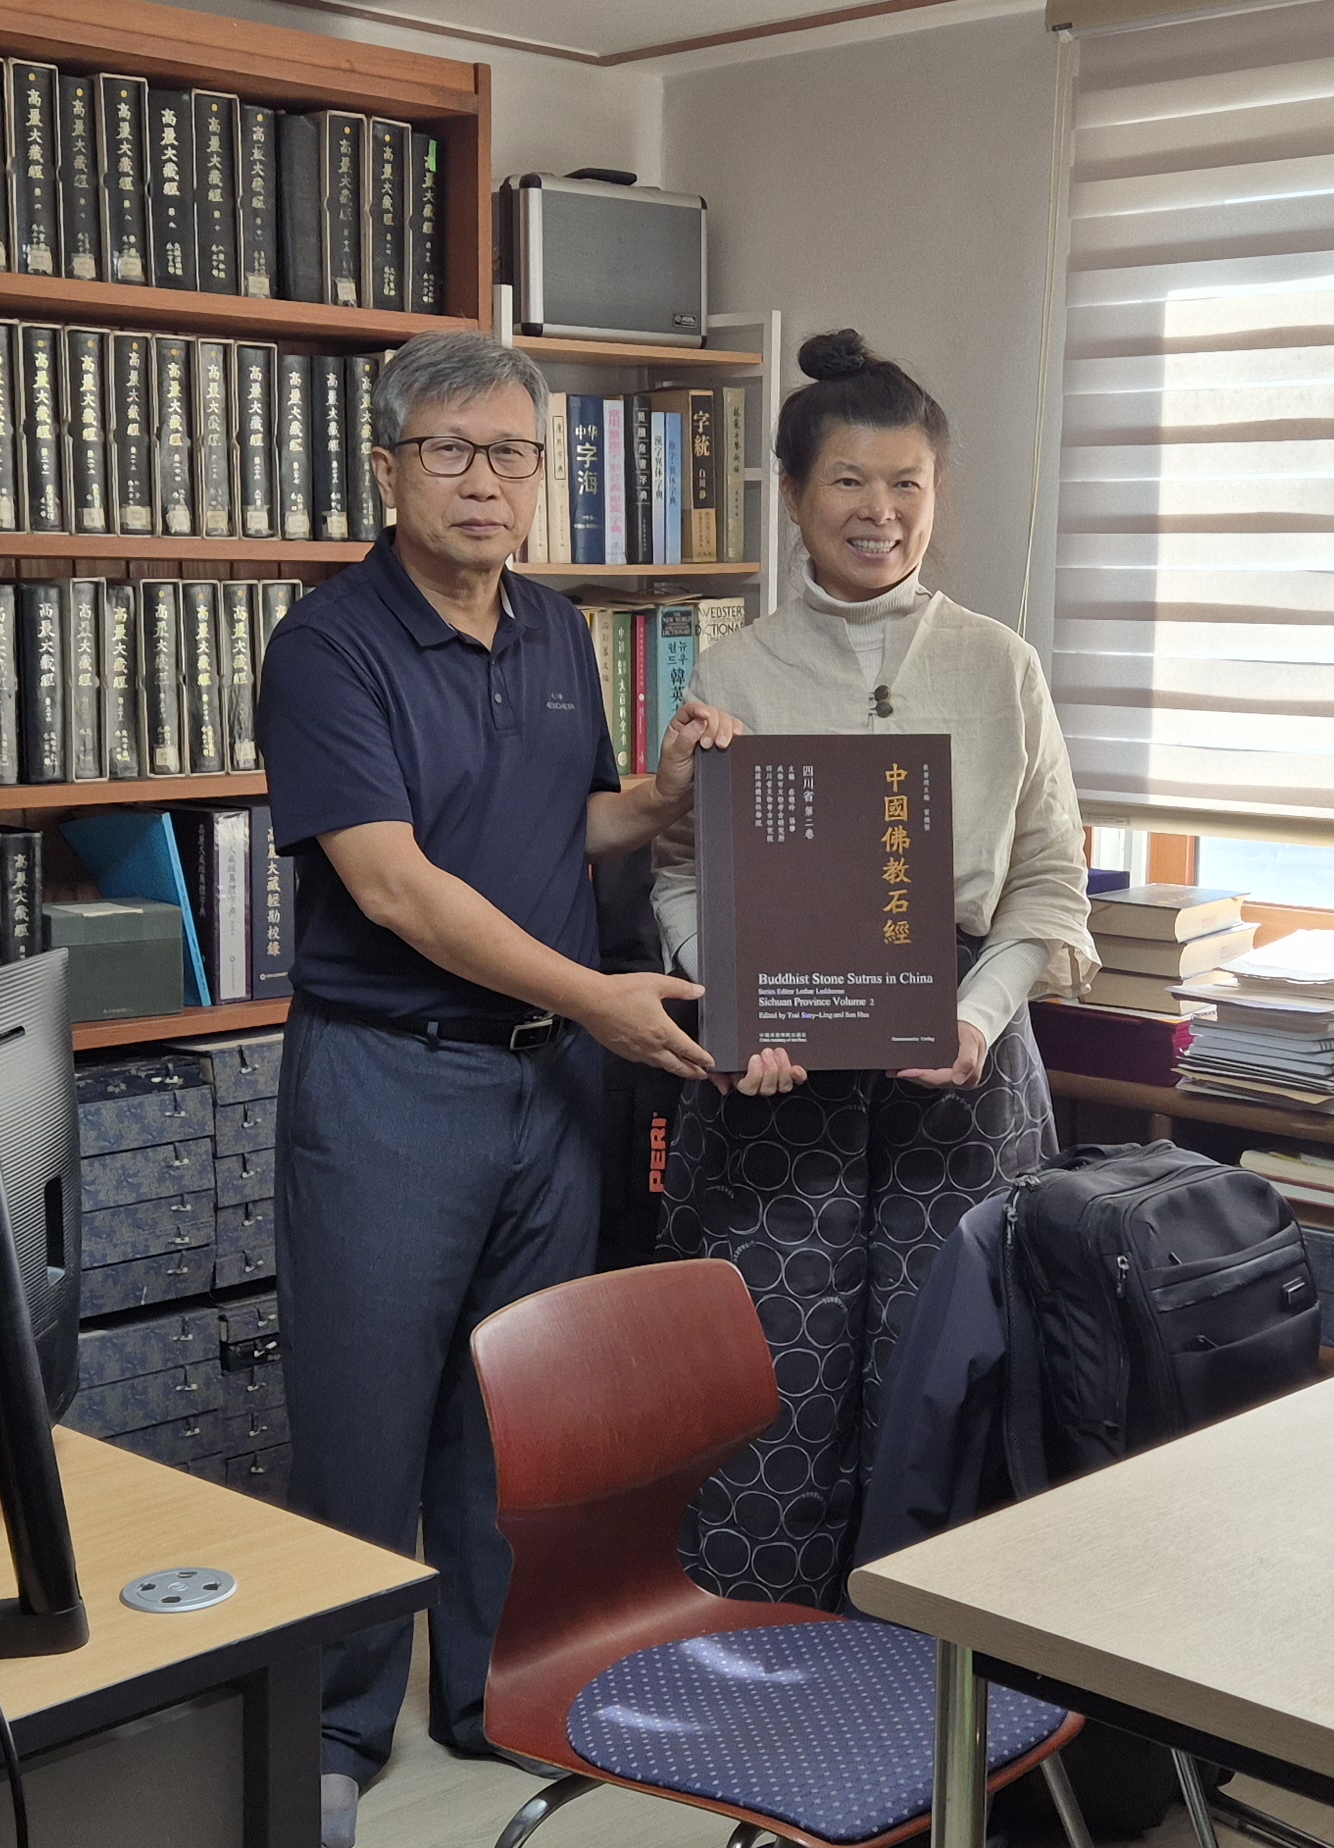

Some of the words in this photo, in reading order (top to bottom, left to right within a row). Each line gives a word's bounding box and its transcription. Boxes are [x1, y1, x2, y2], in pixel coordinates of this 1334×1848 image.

[576, 442, 598, 495] 字海
[802, 765, 814, 802] 四川省
[880, 763, 912, 945] 中國佛教石經
[758, 973, 809, 985] Buddhist
[812, 973, 845, 985] Stone
[847, 973, 882, 984] Sutras
[885, 972, 896, 984] in
[899, 972, 933, 984] China
[758, 997, 793, 1007] Sichuan
[794, 997, 831, 1007] Province
[832, 997, 866, 1007] Volume
[869, 998, 875, 1006] 2
[649, 1118, 667, 1192] PERI
